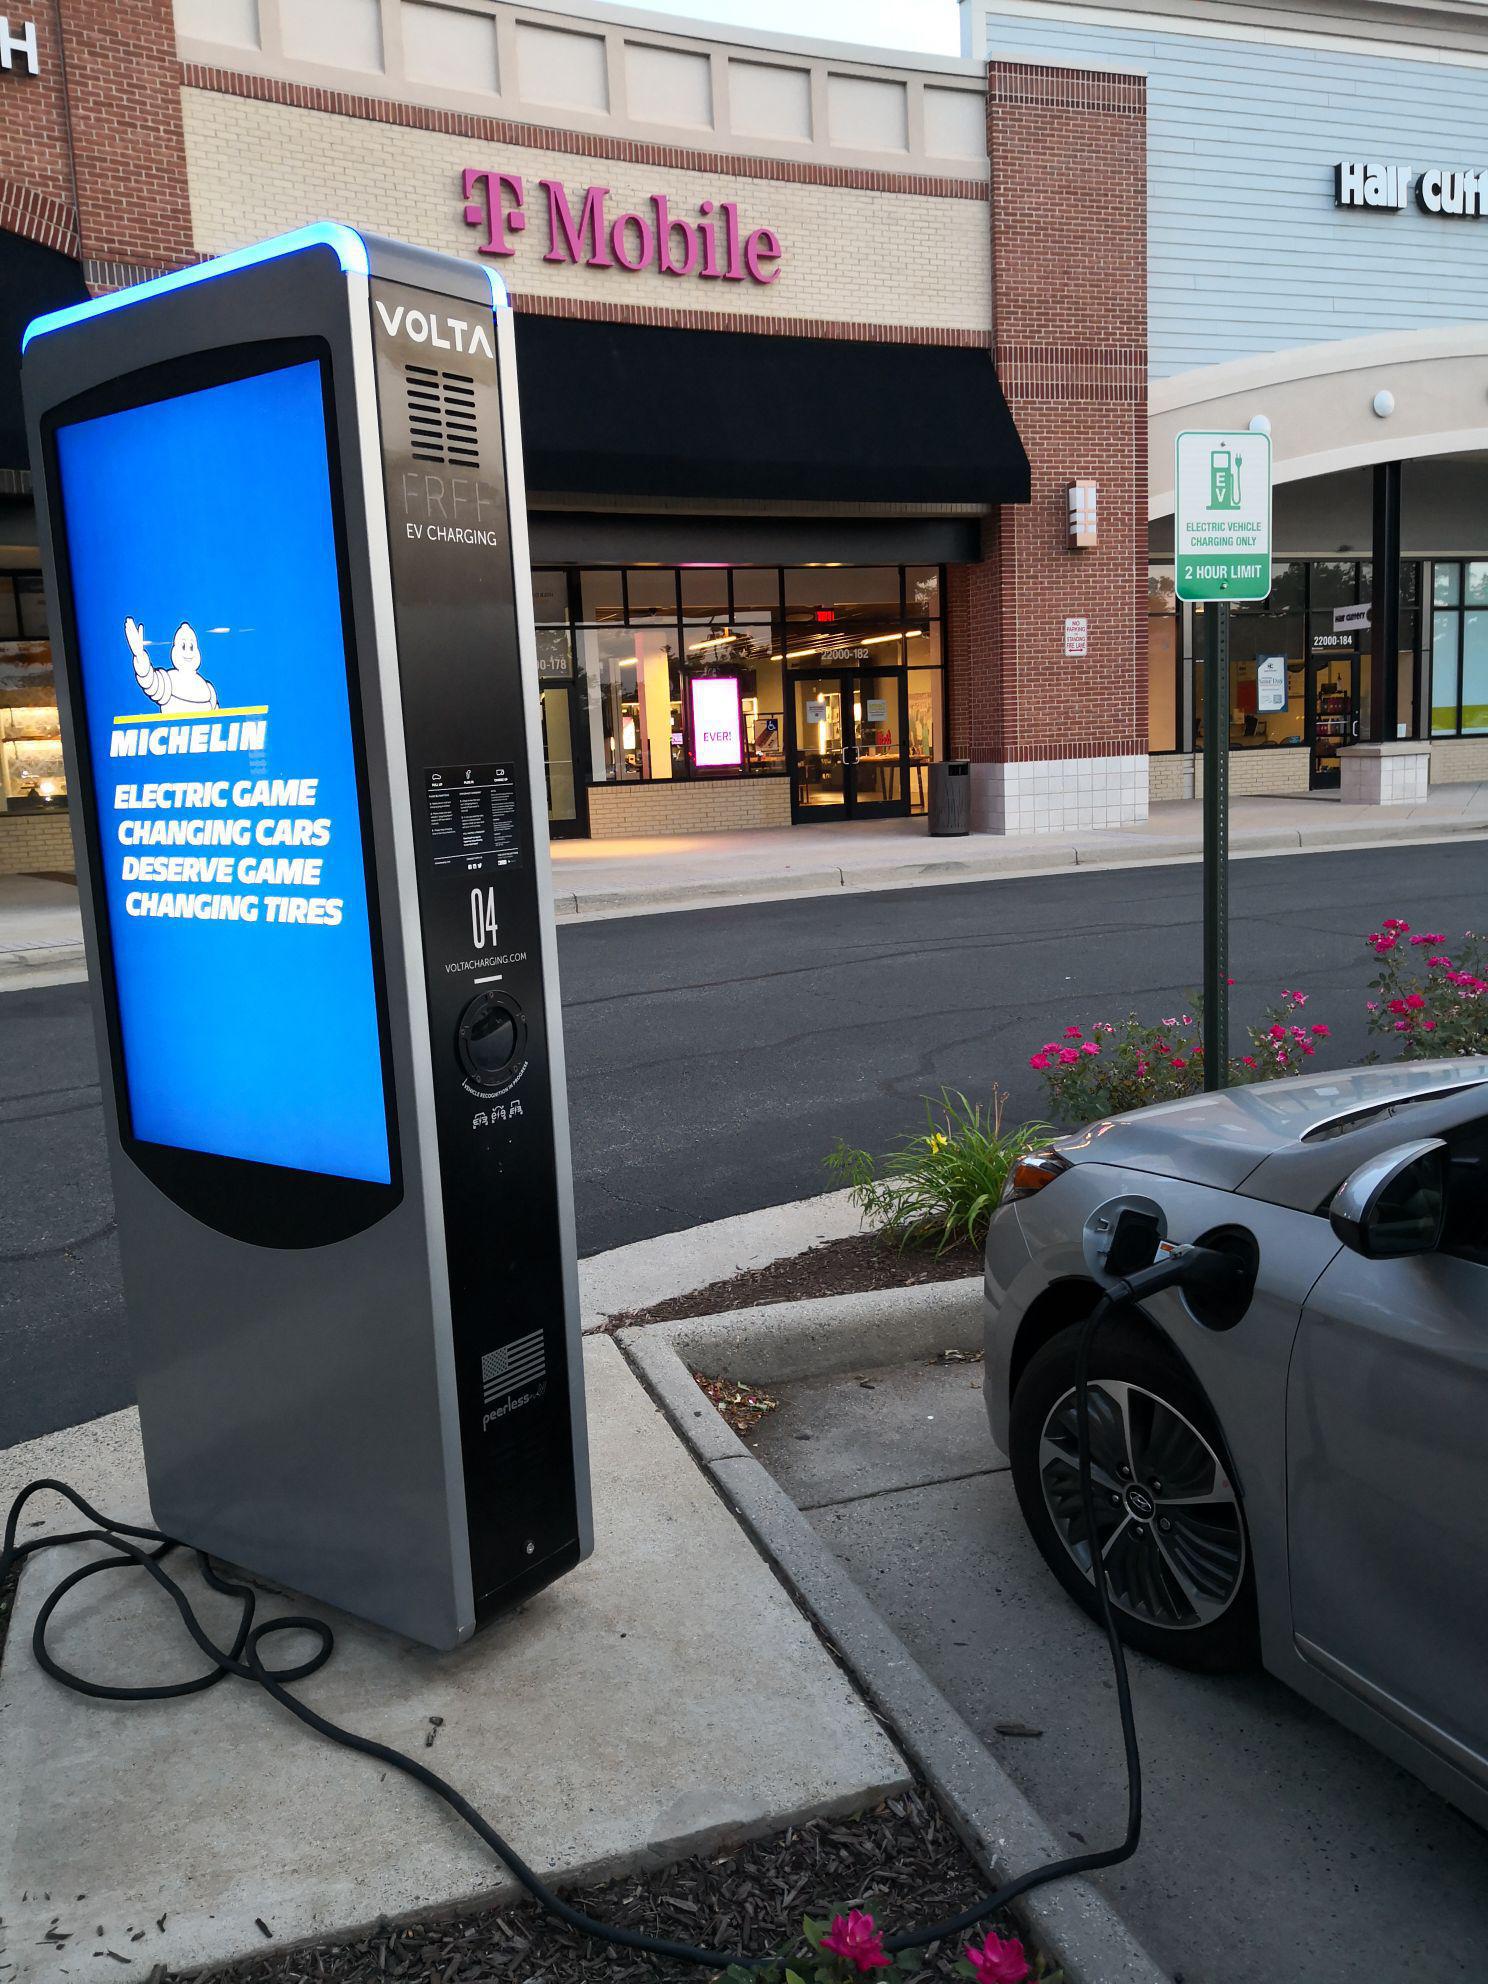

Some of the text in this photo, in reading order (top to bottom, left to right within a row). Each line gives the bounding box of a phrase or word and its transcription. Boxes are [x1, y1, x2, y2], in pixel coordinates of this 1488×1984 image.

[1337, 161, 1411, 208] Hair
[376, 301, 494, 359] VOLTA
[406, 523, 497, 546] EV CHARGING
[1186, 522, 1262, 532] ELECTRIC VEHICLE
[1190, 536, 1257, 547] CHARGING ONLY
[1184, 565, 1262, 580] 2 HOUR LIMIT
[1313, 635, 1353, 646] 22000-184
[537, 659, 567, 670] 0-178
[821, 649, 869, 660] 22000-182
[110, 721, 267, 757] MICHELIN
[703, 731, 732, 742] EVER!
[114, 778, 319, 809] ELECTRIC GAME
[118, 818, 331, 846] CHANGING CARS
[122, 856, 323, 885] DESERVE GAME
[125, 891, 344, 926] CHANGING TIRES
[471, 886, 498, 949] 04
[445, 951, 527, 973] VOLTACHARGING.COM
